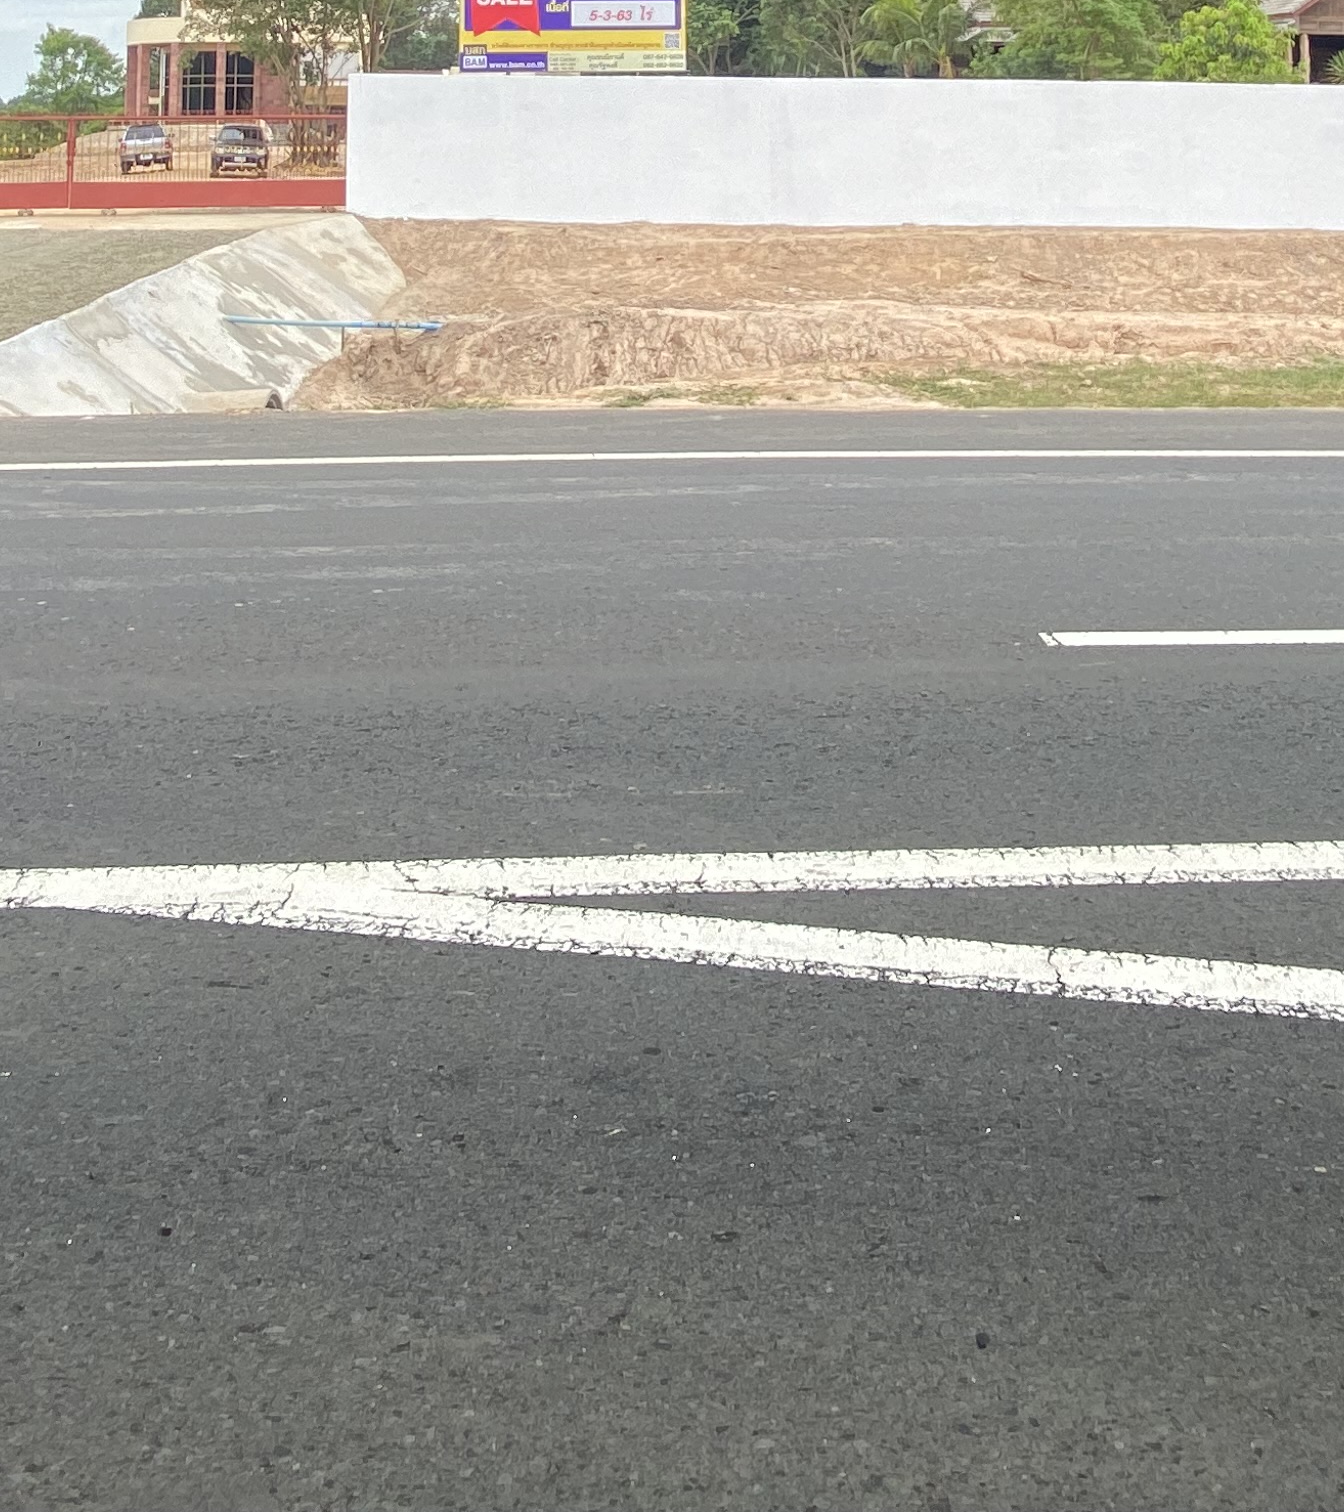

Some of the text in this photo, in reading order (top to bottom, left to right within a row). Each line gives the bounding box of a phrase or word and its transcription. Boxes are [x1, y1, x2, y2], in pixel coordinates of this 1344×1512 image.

[545, 0, 570, 13] เนื้อที่
[589, 5, 655, 21] 5-3-63 ไร่
[464, 58, 486, 66] BAM
[489, 61, 545, 69] www.bam.co.th
